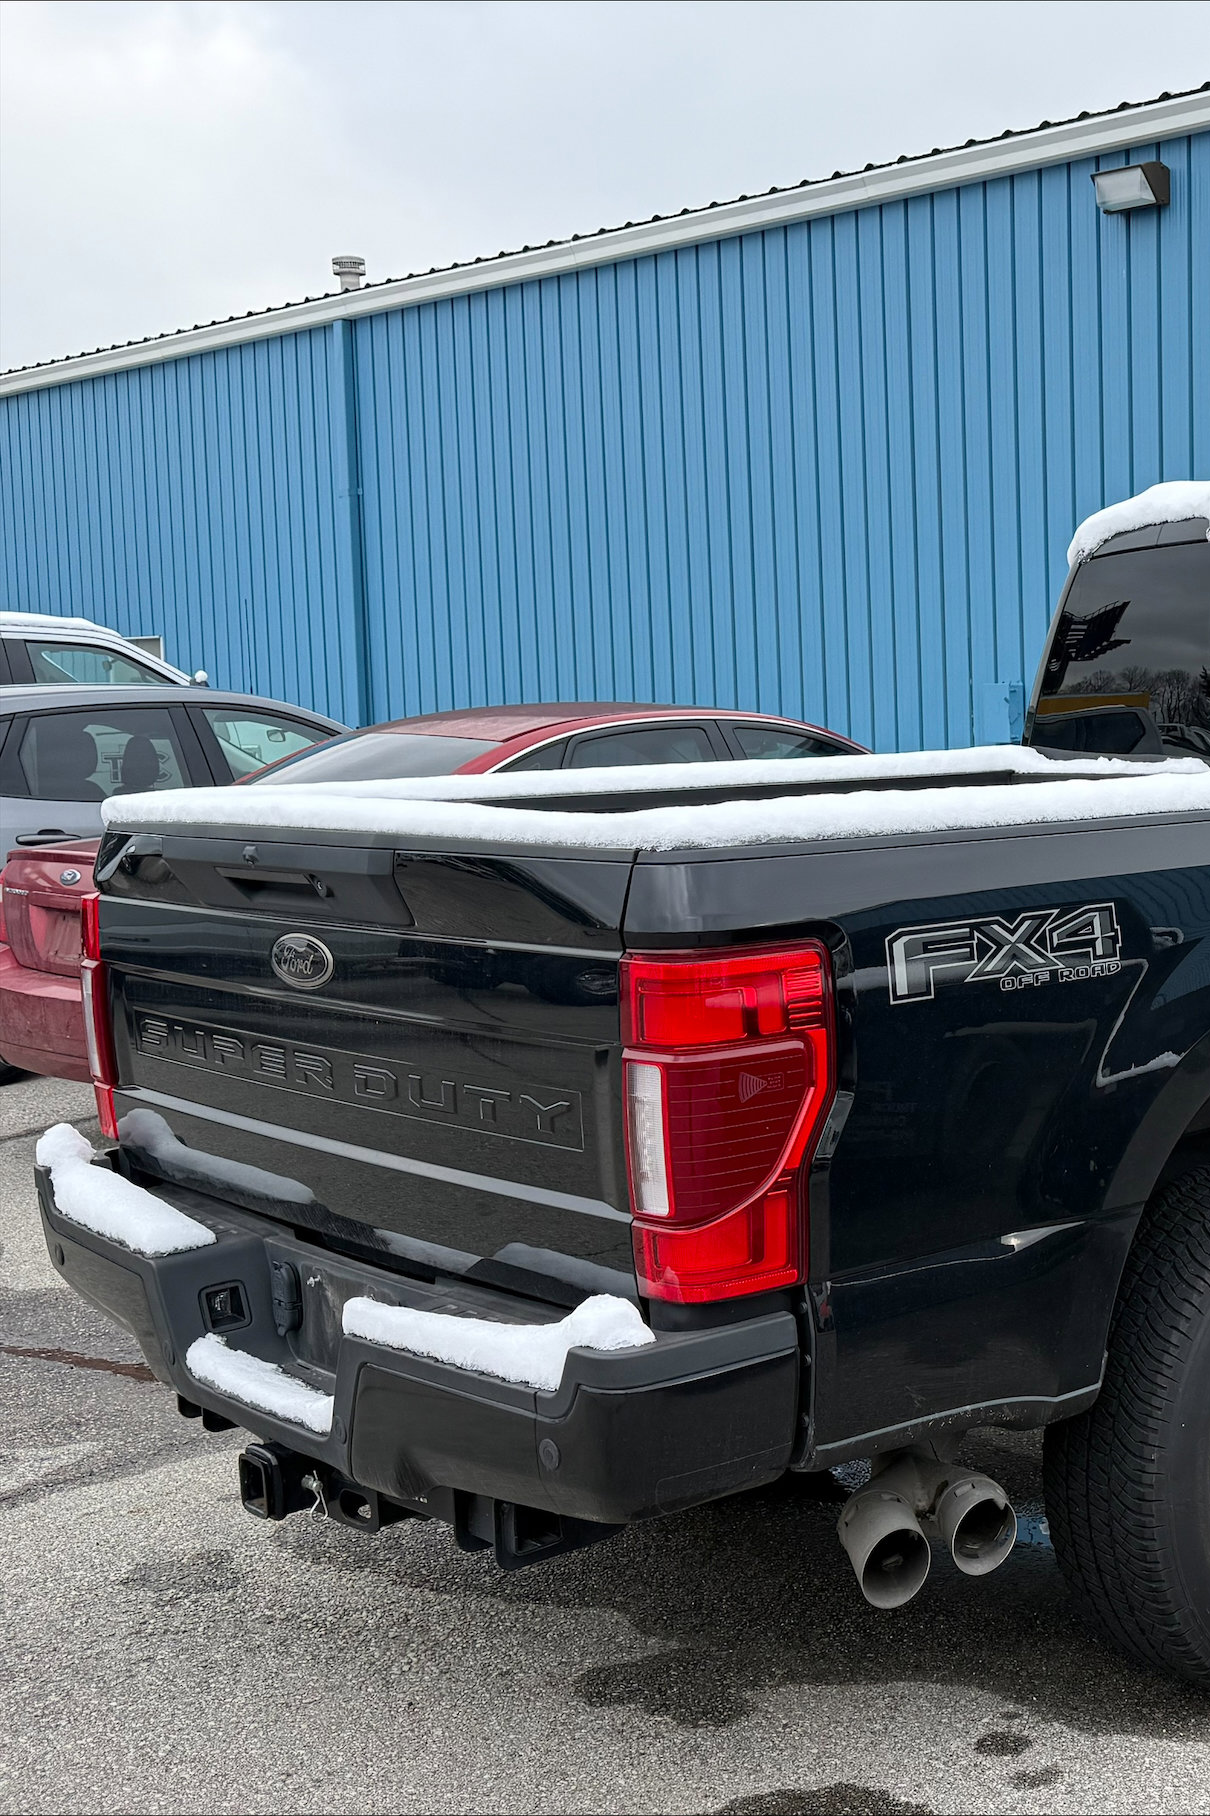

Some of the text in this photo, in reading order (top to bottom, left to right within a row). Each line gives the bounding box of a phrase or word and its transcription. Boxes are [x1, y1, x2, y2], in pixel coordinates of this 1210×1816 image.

[281, 943, 314, 976] Ford
[885, 902, 1122, 1005] FX4
[1000, 960, 1122, 992] OFF ROAD
[139, 1018, 571, 1135] SUPER DUTY
